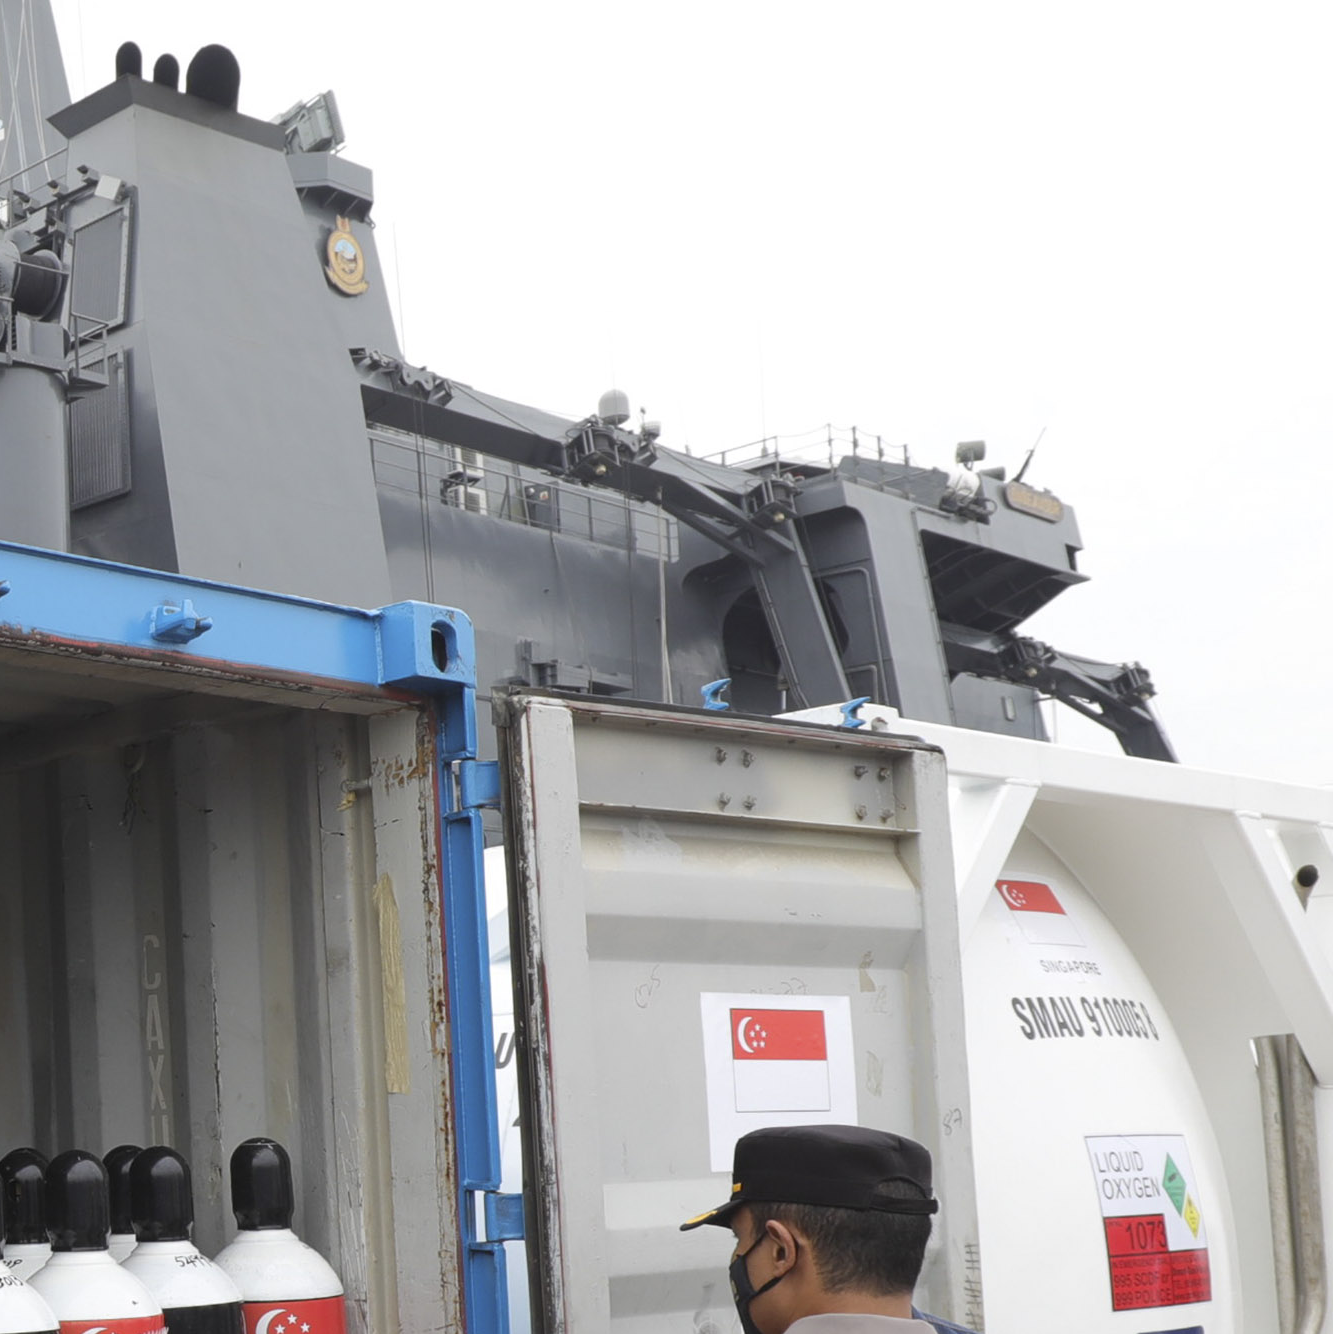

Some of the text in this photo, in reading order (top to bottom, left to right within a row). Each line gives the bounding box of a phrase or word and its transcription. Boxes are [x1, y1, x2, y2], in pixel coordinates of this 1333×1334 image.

[1040, 959, 1101, 976] SINGAPORE
[1011, 996, 1085, 1040] SMAU
[1094, 1151, 1144, 1173] LIQUID
[1102, 1177, 1162, 1200] OXYGEN
[1126, 1220, 1168, 1250] 1073
